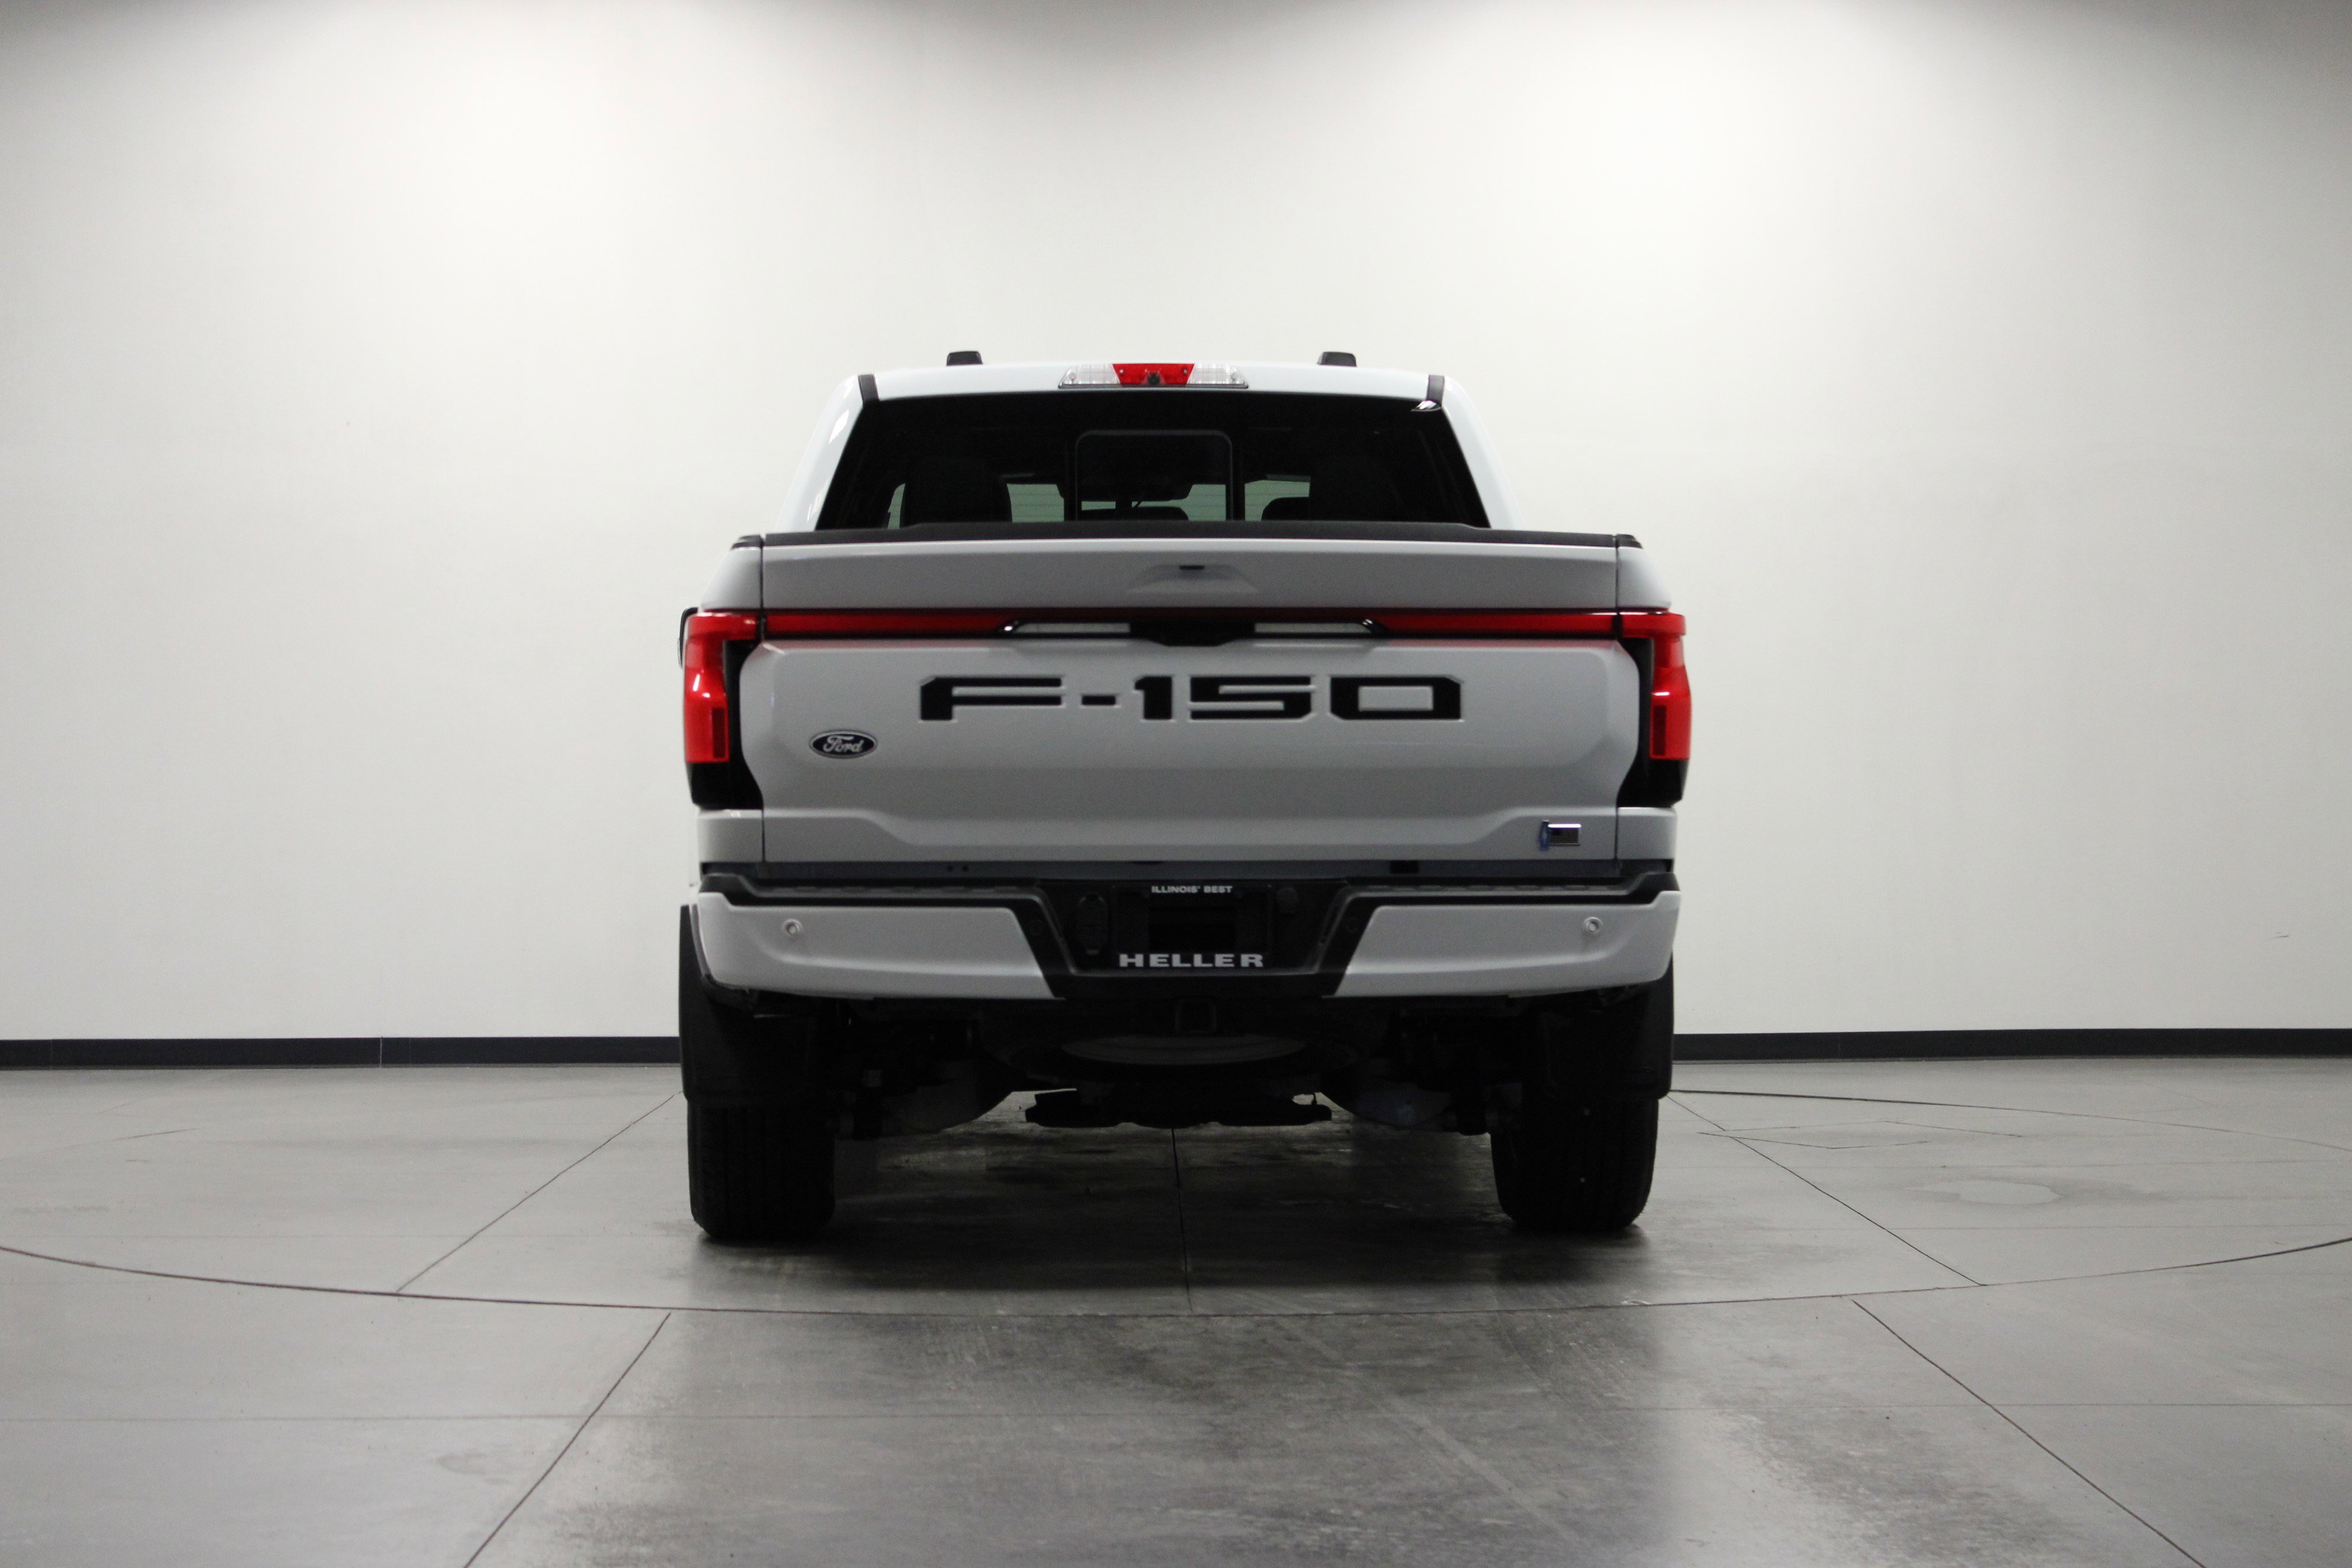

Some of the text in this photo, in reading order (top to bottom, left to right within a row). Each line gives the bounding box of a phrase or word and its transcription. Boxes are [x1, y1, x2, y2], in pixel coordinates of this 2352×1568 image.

[920, 676, 1462, 720] F-150
[823, 735, 864, 752] Ford
[1119, 953, 1263, 967] HELLER
